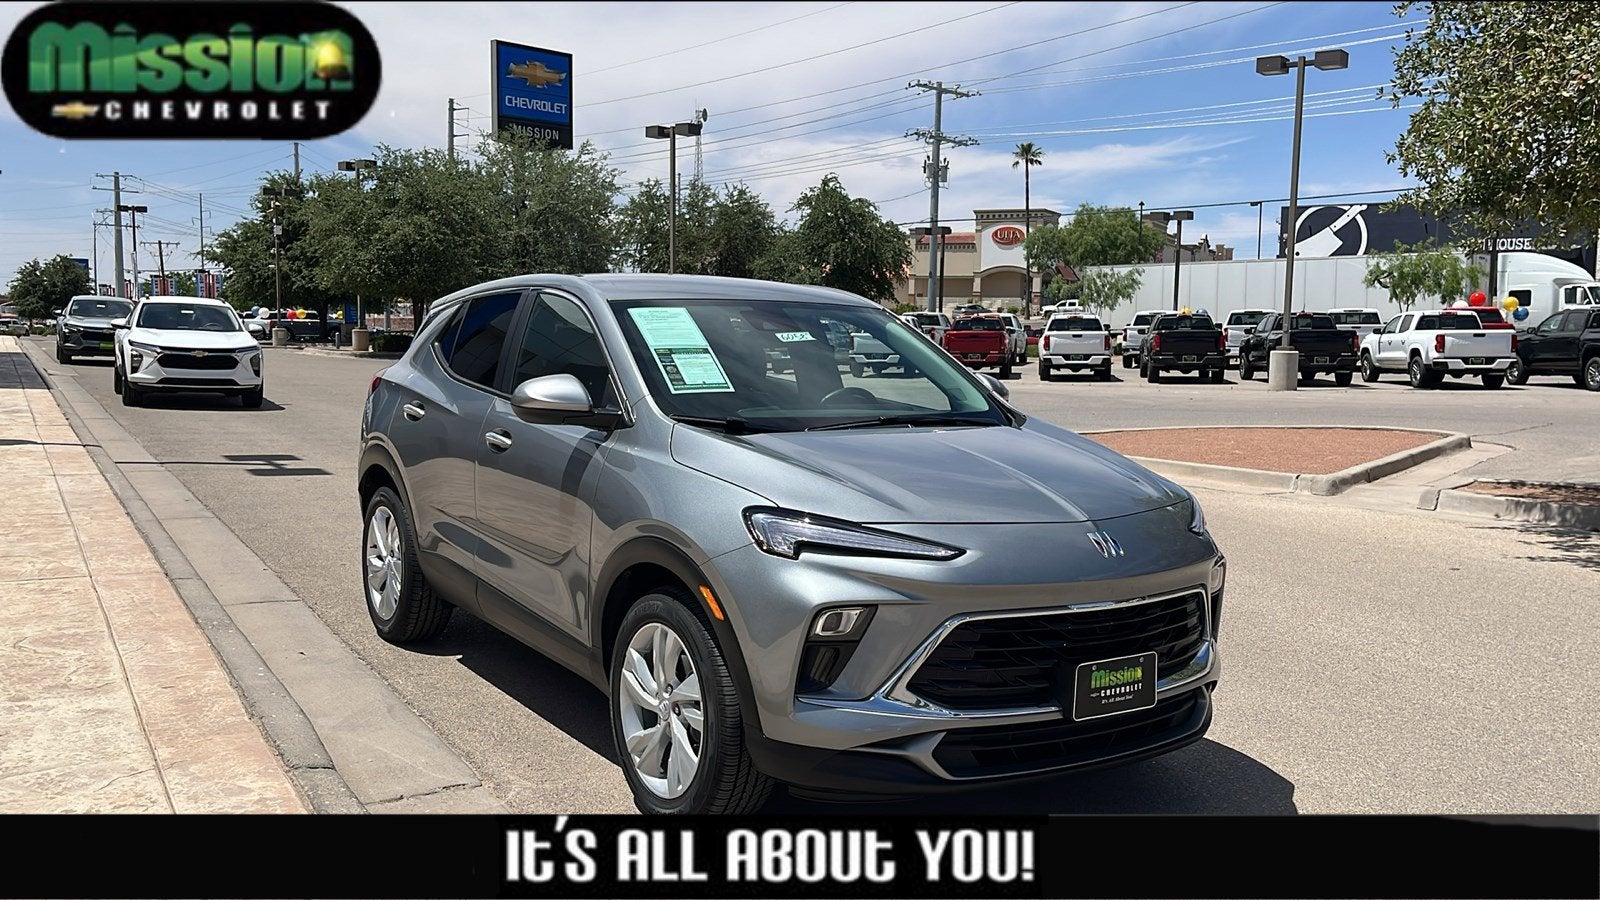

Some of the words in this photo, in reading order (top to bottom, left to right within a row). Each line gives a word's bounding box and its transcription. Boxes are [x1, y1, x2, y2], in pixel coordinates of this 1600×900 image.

[505, 95, 567, 114] CHEVROLET
[513, 124, 559, 141] MISSION
[997, 230, 1020, 239] ULTA
[1091, 666, 1142, 689] Mission
[1101, 683, 1142, 697] CHEVROLET
